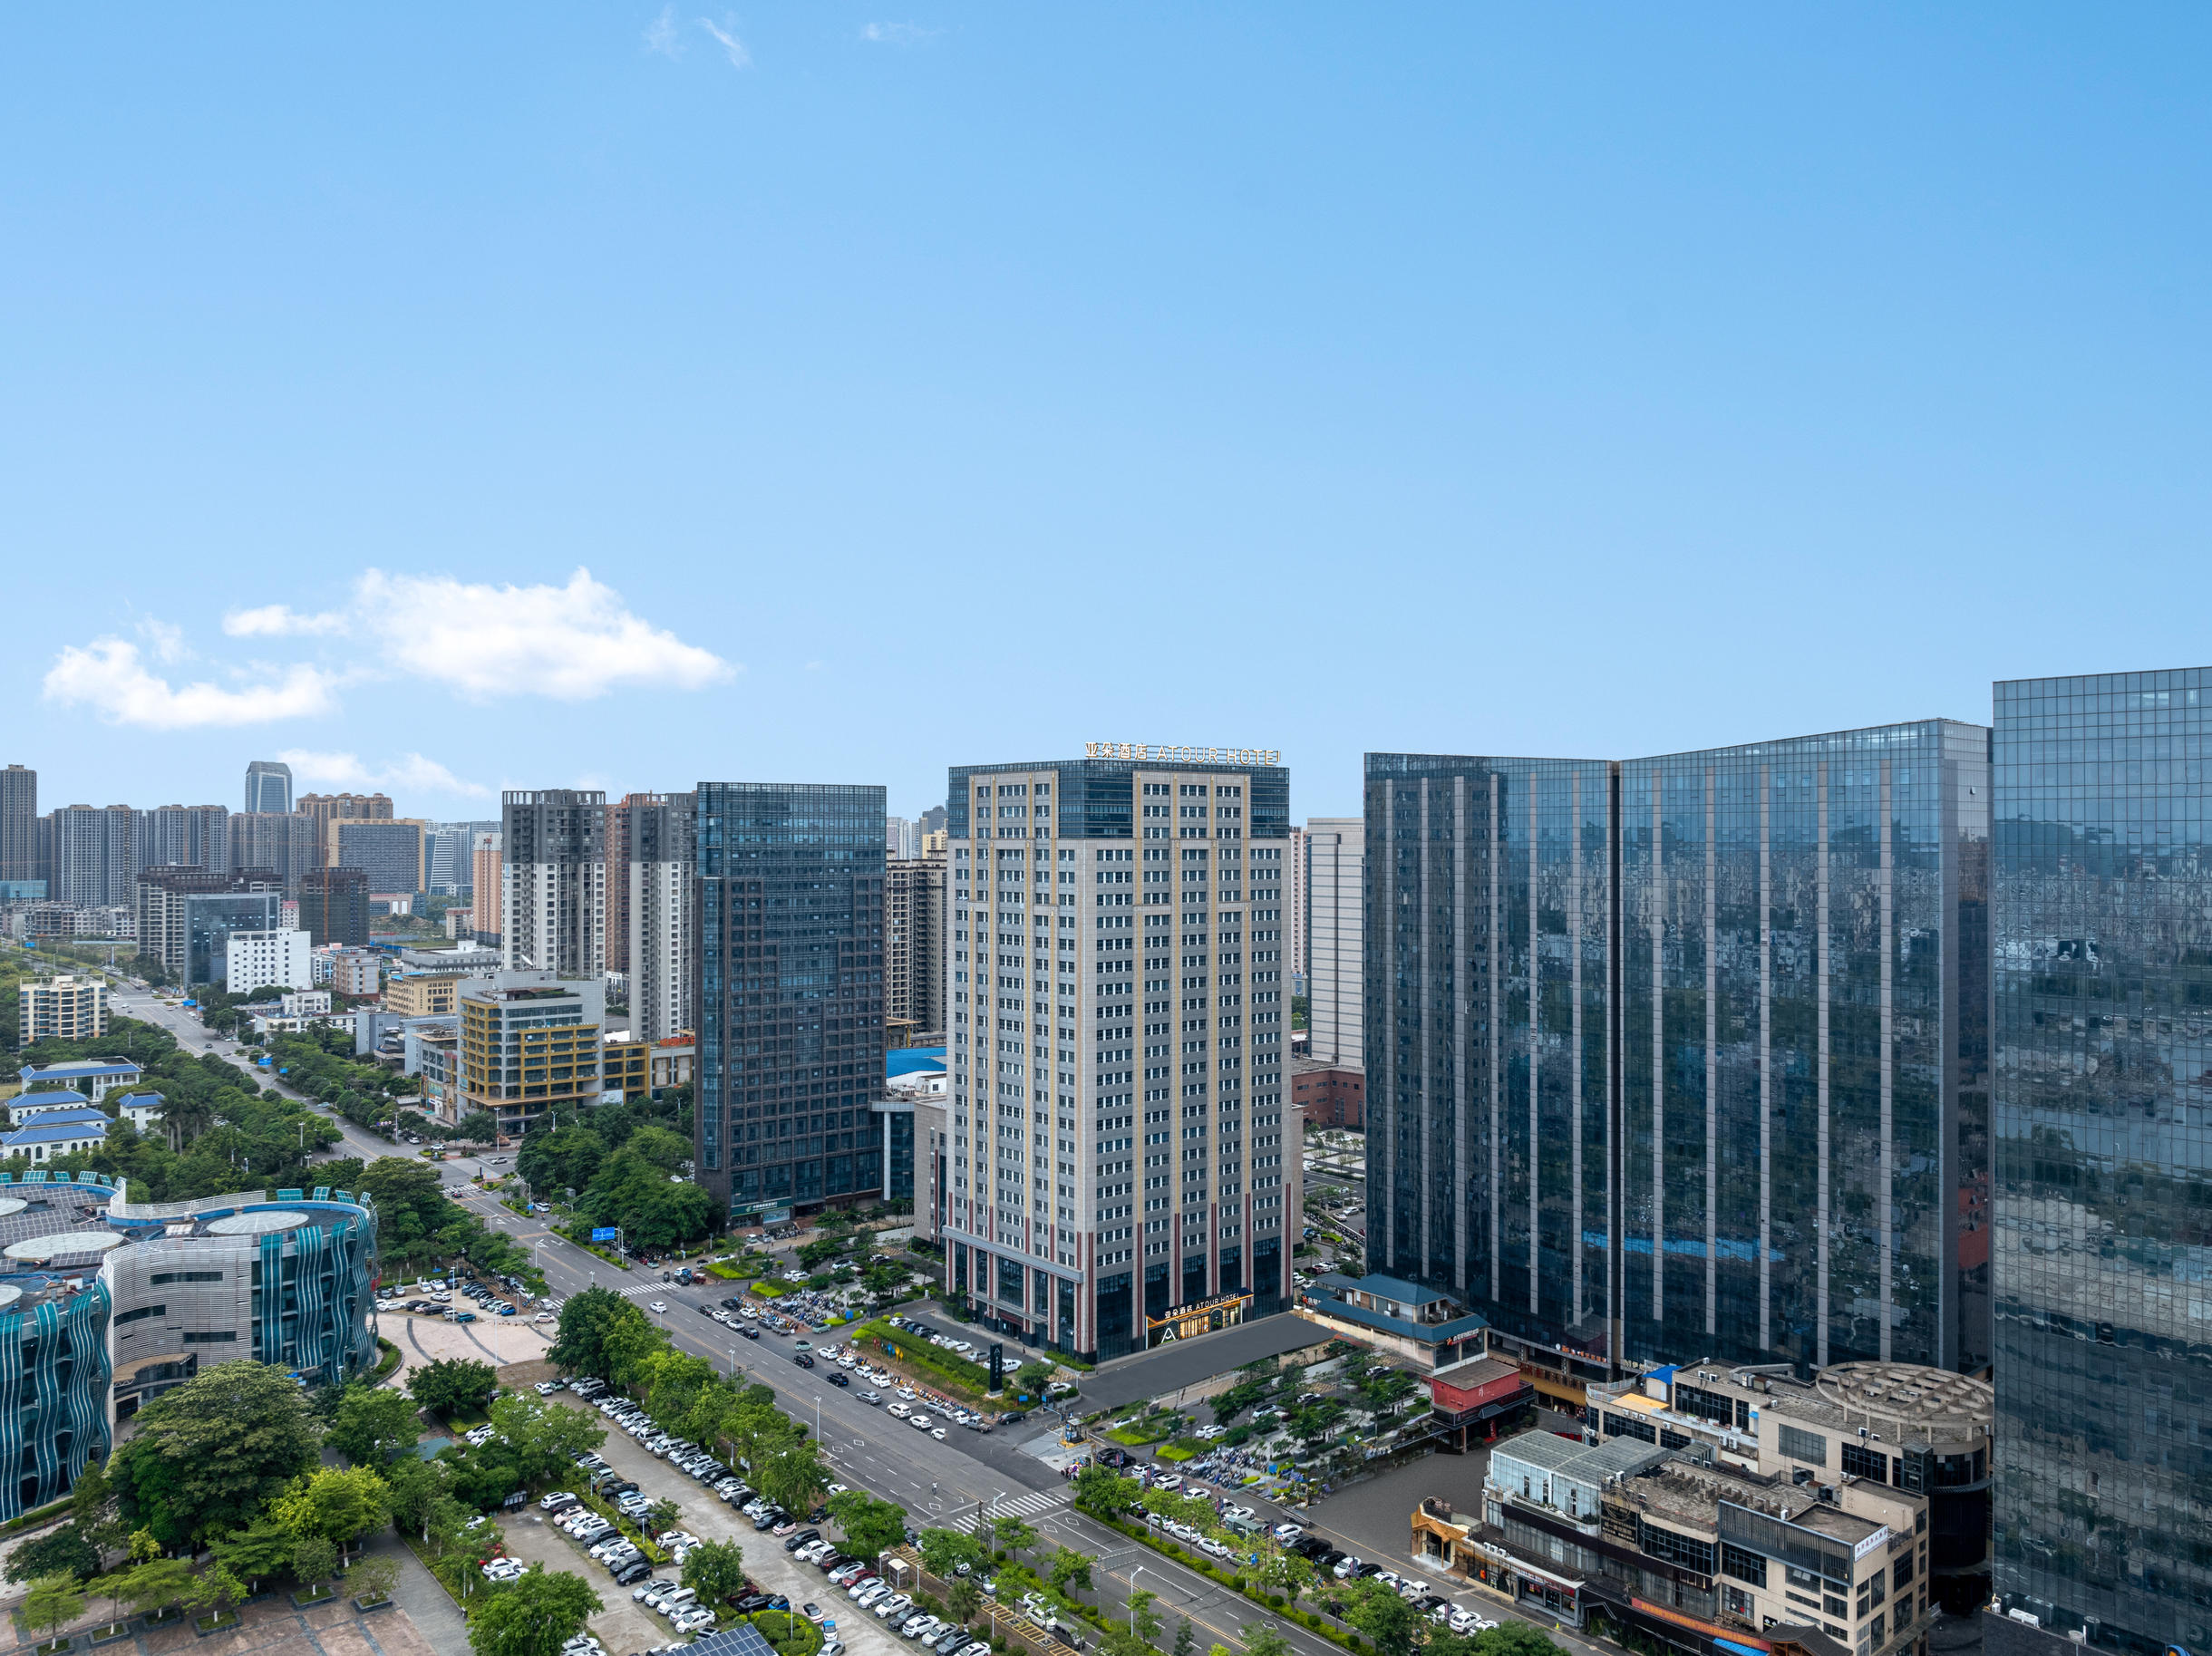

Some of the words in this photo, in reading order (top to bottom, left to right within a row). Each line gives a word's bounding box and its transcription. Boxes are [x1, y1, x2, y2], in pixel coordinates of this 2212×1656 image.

[1085, 741, 1148, 760] 亚朵酒店
[1157, 745, 1218, 763] ATOUR
[1196, 1299, 1218, 1310] ATOUR
[1221, 1293, 1240, 1303] HOTEL
